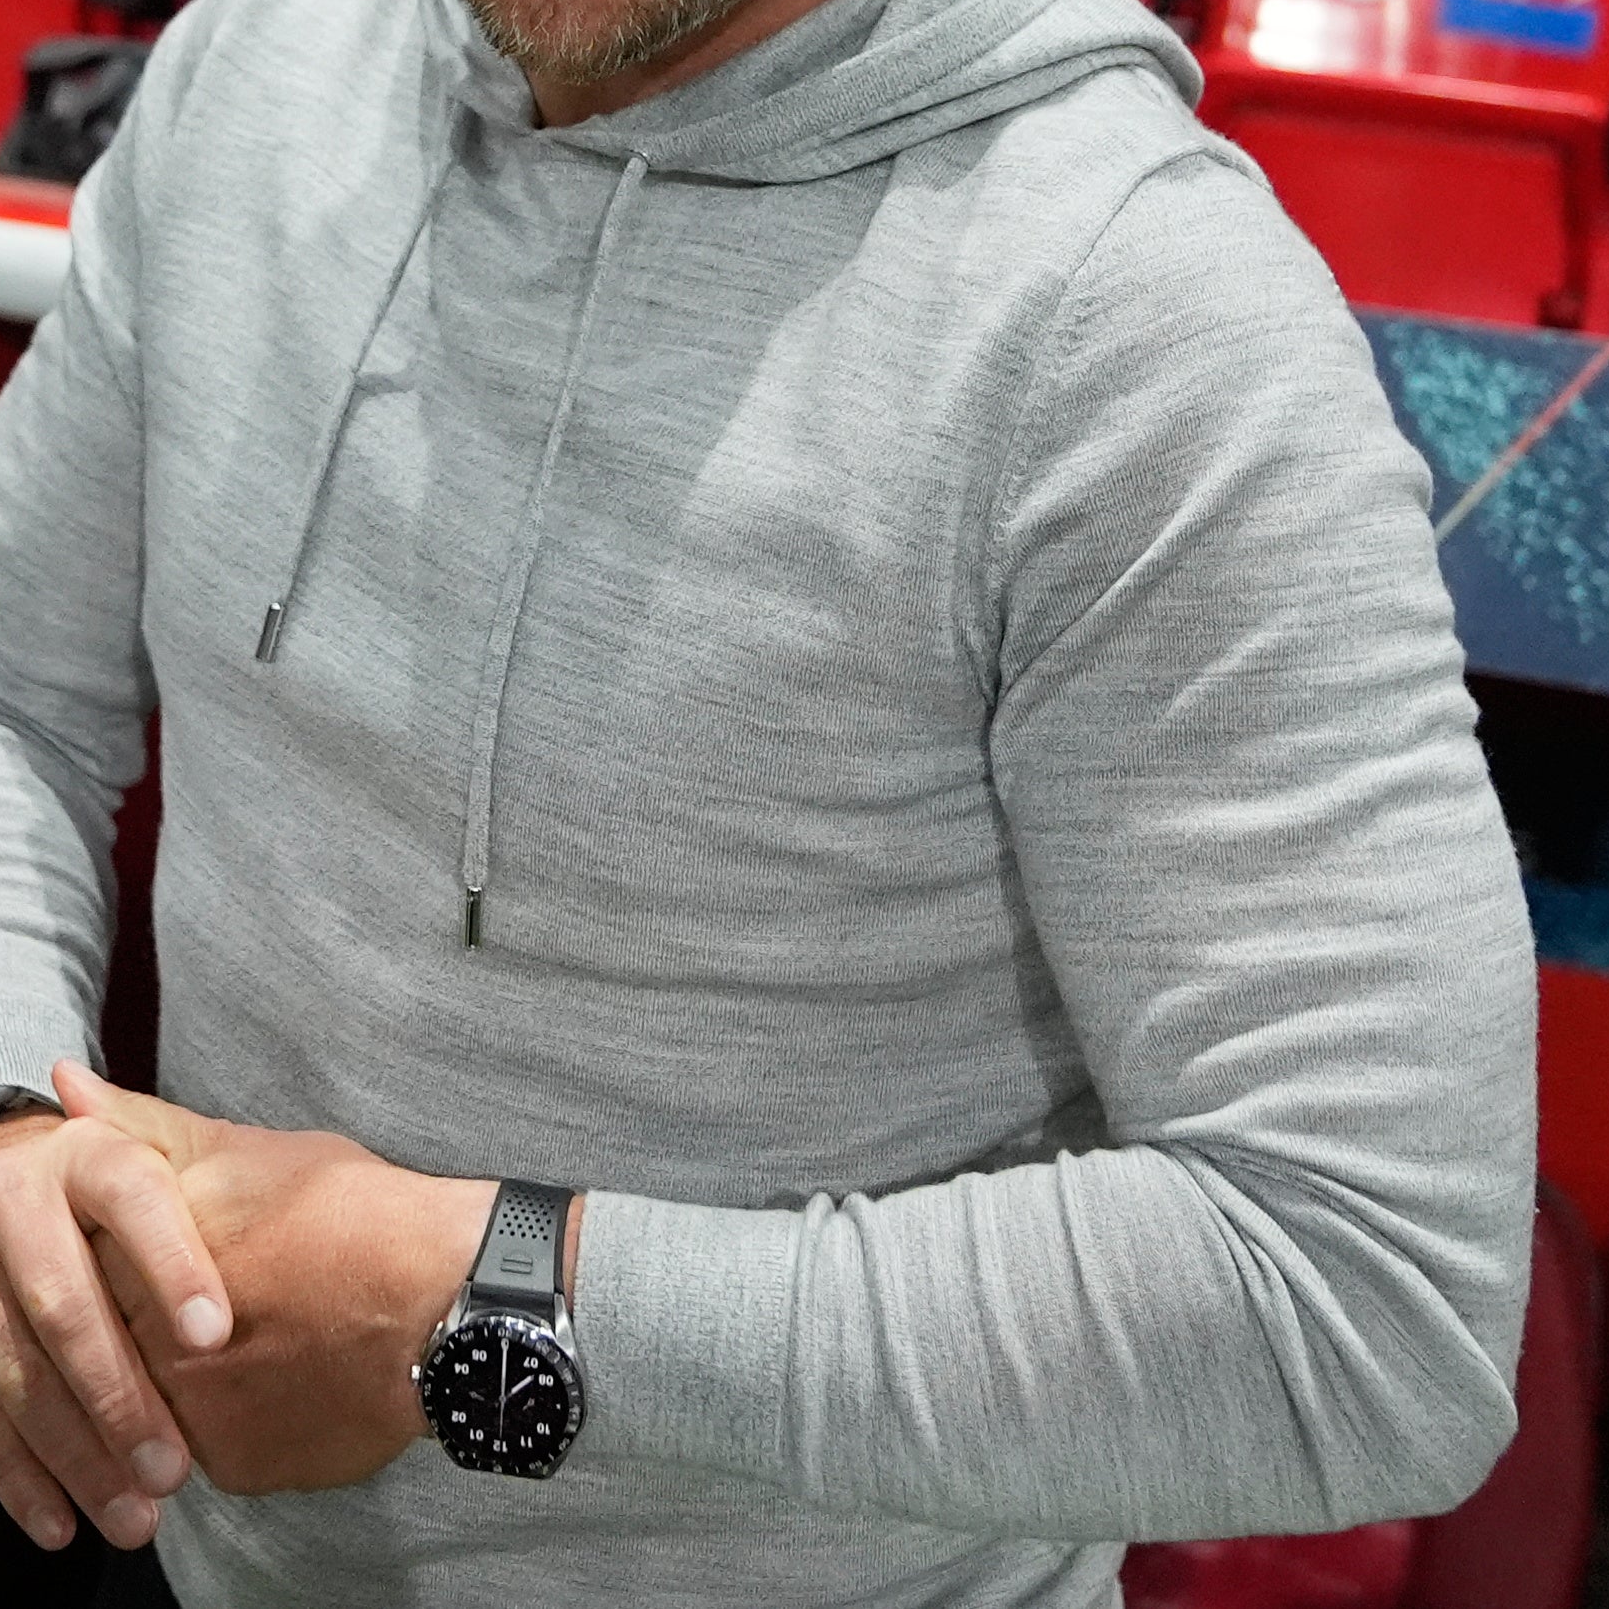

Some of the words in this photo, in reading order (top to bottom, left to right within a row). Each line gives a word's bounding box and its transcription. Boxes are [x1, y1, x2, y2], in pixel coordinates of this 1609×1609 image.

[471, 1348, 488, 1363] 05
[522, 1356, 539, 1369] 07
[453, 1362, 470, 1376] 04
[538, 1373, 554, 1387] 08
[451, 1409, 467, 1424] 02
[469, 1427, 484, 1442] 01
[536, 1421, 551, 1436] 10
[492, 1438, 508, 1454] 12
[520, 1434, 534, 1449] 11
